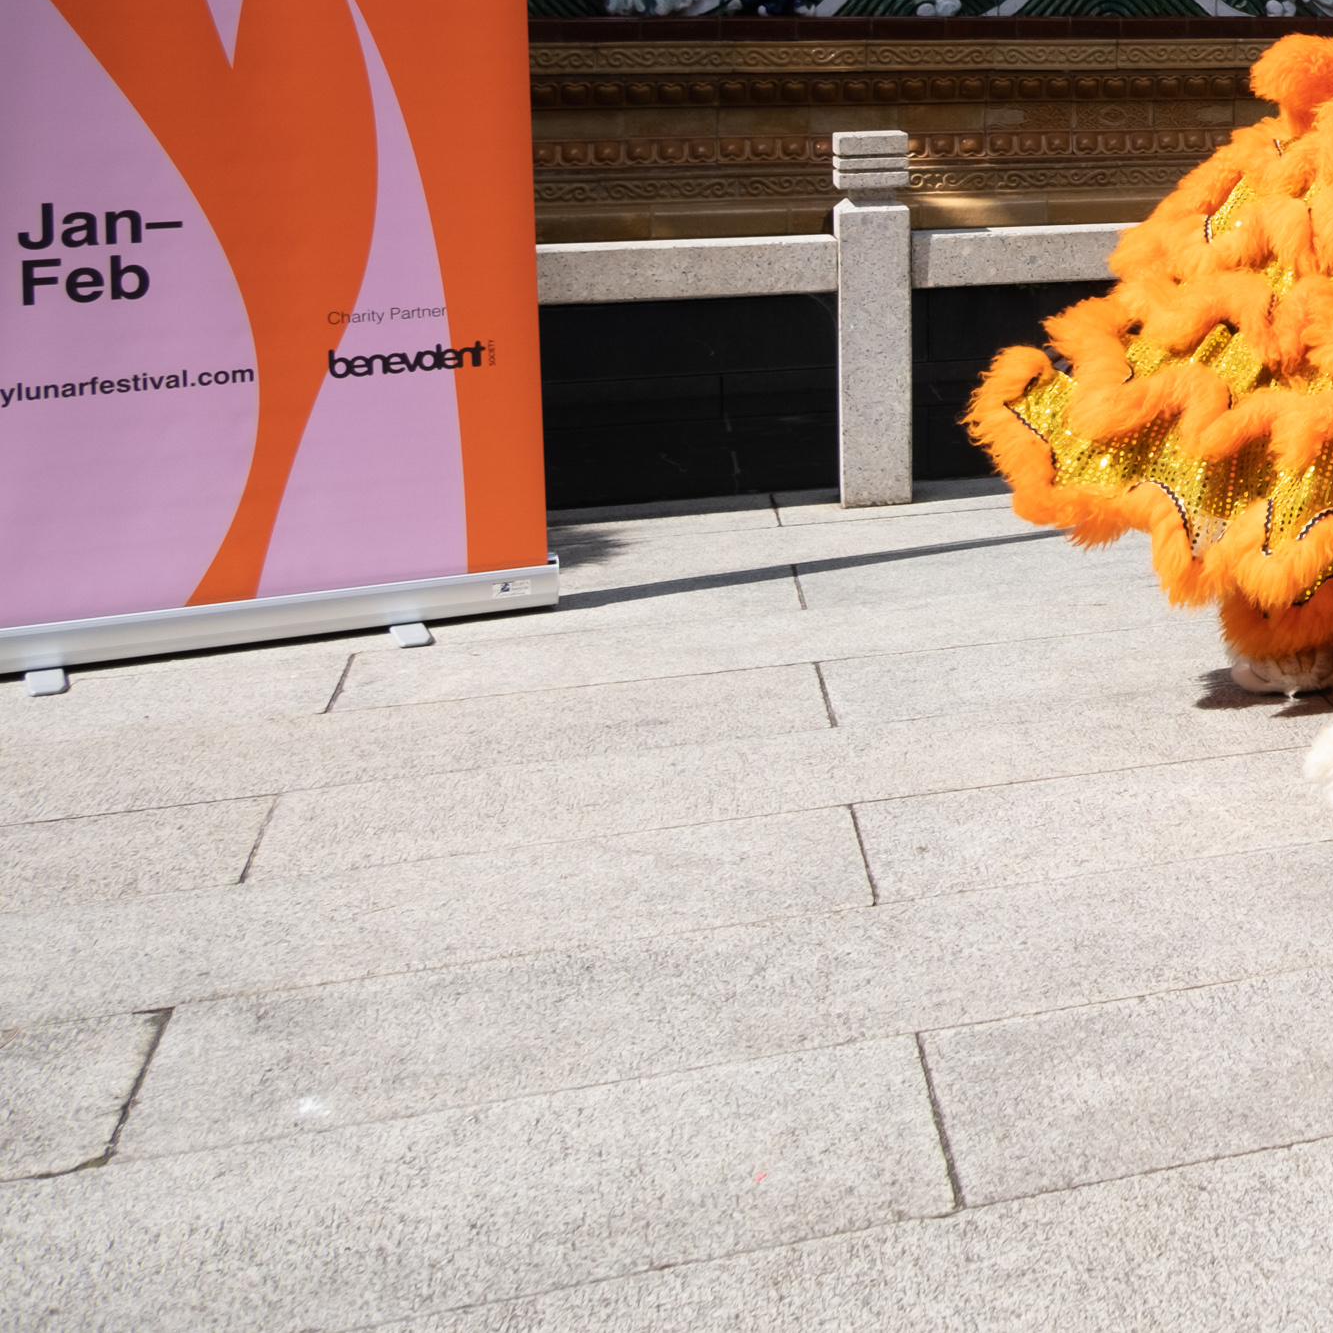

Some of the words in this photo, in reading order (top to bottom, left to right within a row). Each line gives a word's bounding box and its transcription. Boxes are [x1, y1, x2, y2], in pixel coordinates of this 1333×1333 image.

[21, 256, 150, 306] Feb
[328, 309, 385, 325] Charity
[390, 306, 447, 320] Partner
[328, 340, 486, 379] benevolent
[488, 339, 496, 367] SOCIETY
